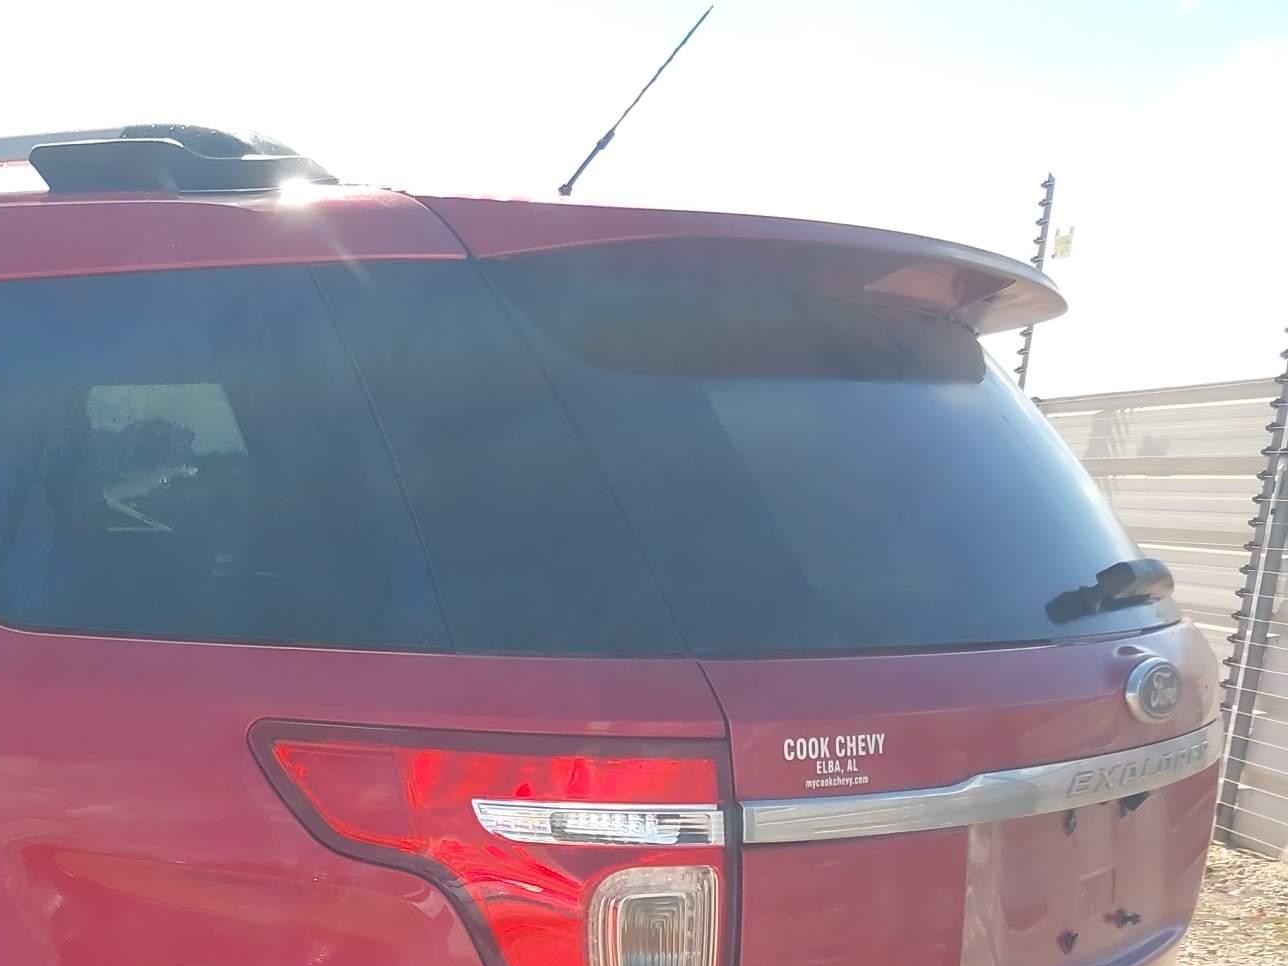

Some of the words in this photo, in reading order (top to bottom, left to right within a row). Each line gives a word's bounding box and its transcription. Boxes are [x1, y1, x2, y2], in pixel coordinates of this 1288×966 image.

[783, 736, 830, 761] COOK
[835, 733, 886, 757] CHEVY
[816, 760, 844, 775] ELBA,
[846, 758, 859, 772] AL
[1066, 740, 1210, 799] EXPLOR
[805, 775, 869, 790] mycookchevy.com
